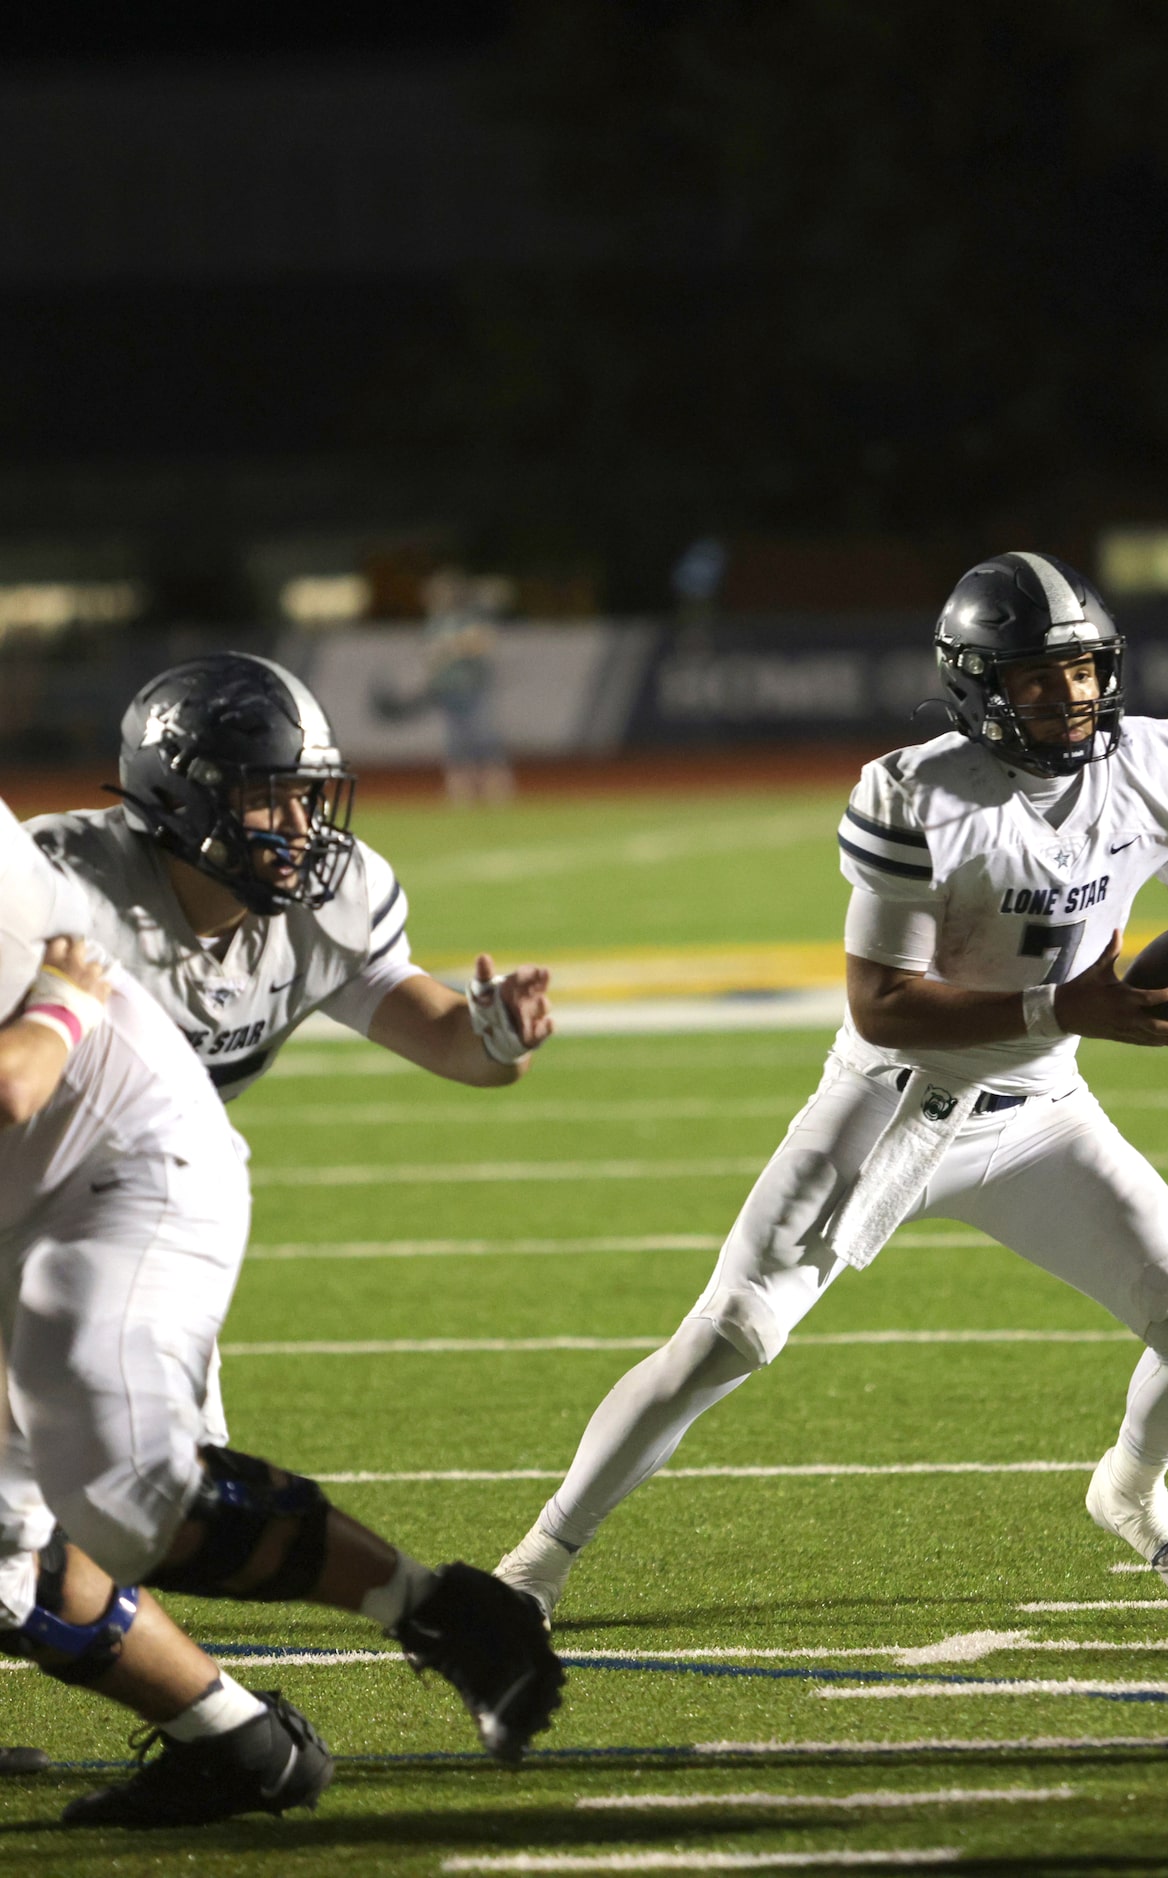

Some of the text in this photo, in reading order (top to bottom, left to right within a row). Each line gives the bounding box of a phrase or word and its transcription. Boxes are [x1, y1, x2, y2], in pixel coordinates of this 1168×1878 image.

[1000, 875, 1110, 916] LONE STAR
[1017, 918, 1087, 986] 7
[208, 1019, 266, 1054] STAR
